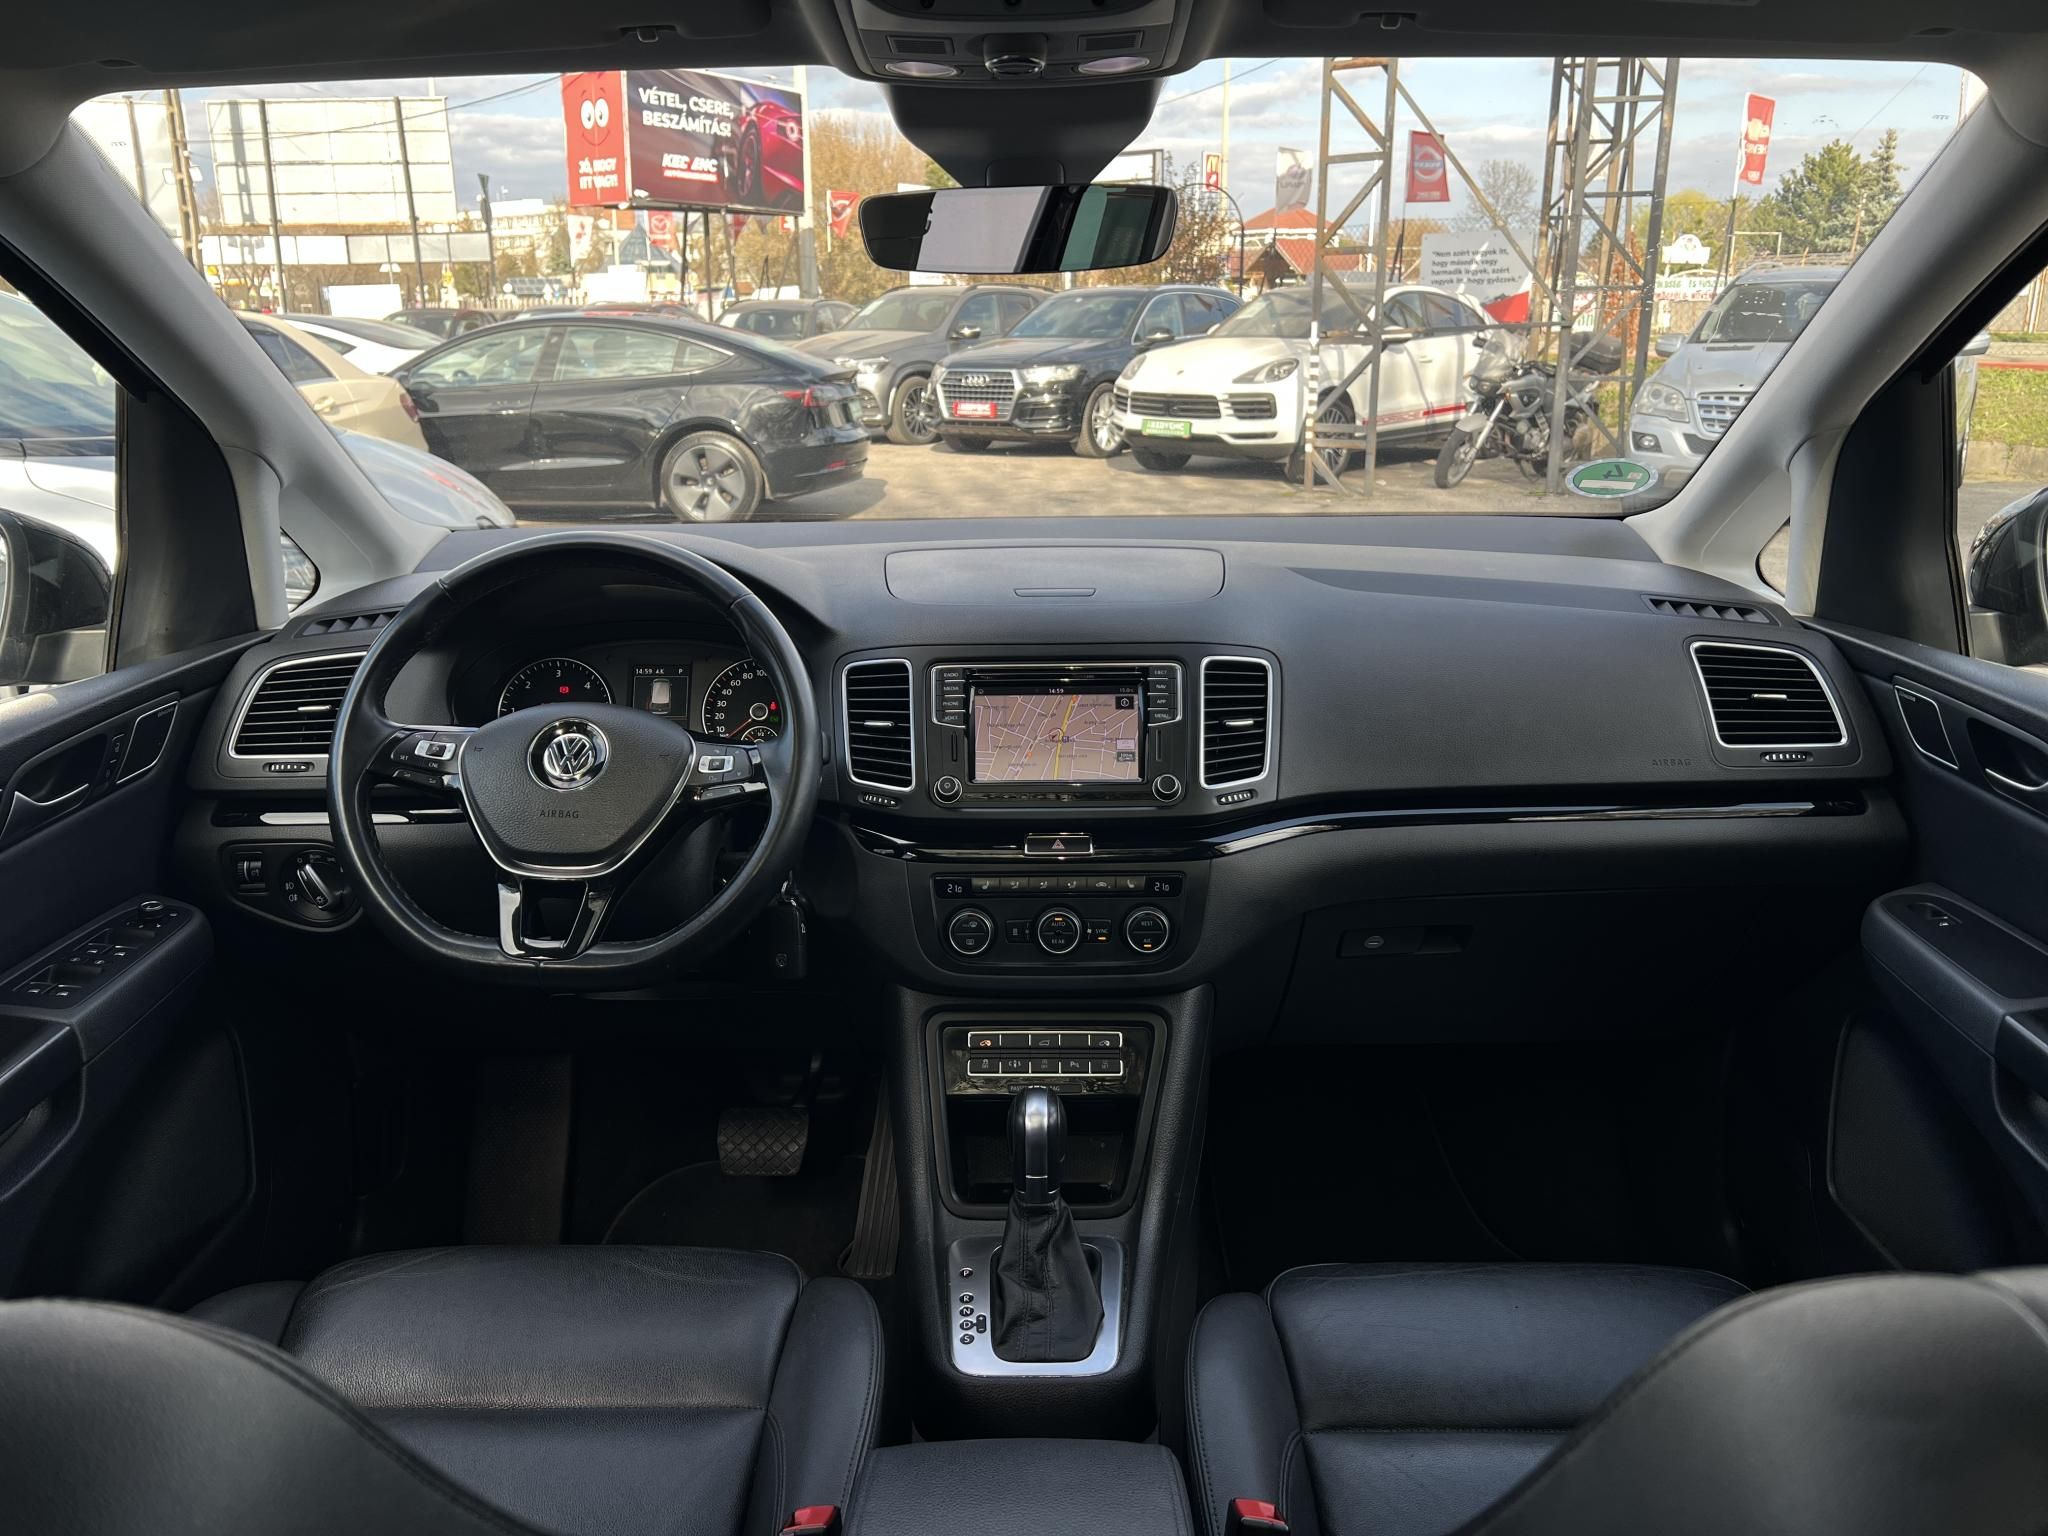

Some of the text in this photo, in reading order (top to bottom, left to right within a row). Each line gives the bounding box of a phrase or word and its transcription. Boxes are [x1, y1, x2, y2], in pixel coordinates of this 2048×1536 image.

[638, 86, 734, 119] VÉTEL, CSERE,
[642, 110, 732, 137] BESZÁMÍTÁS!
[555, 669, 562, 677] 3
[742, 672, 753, 680] 80
[525, 681, 531, 689] 2
[730, 679, 741, 687] 60
[1652, 758, 1691, 767] AIRBAG
[539, 809, 580, 819] AIRBAG
